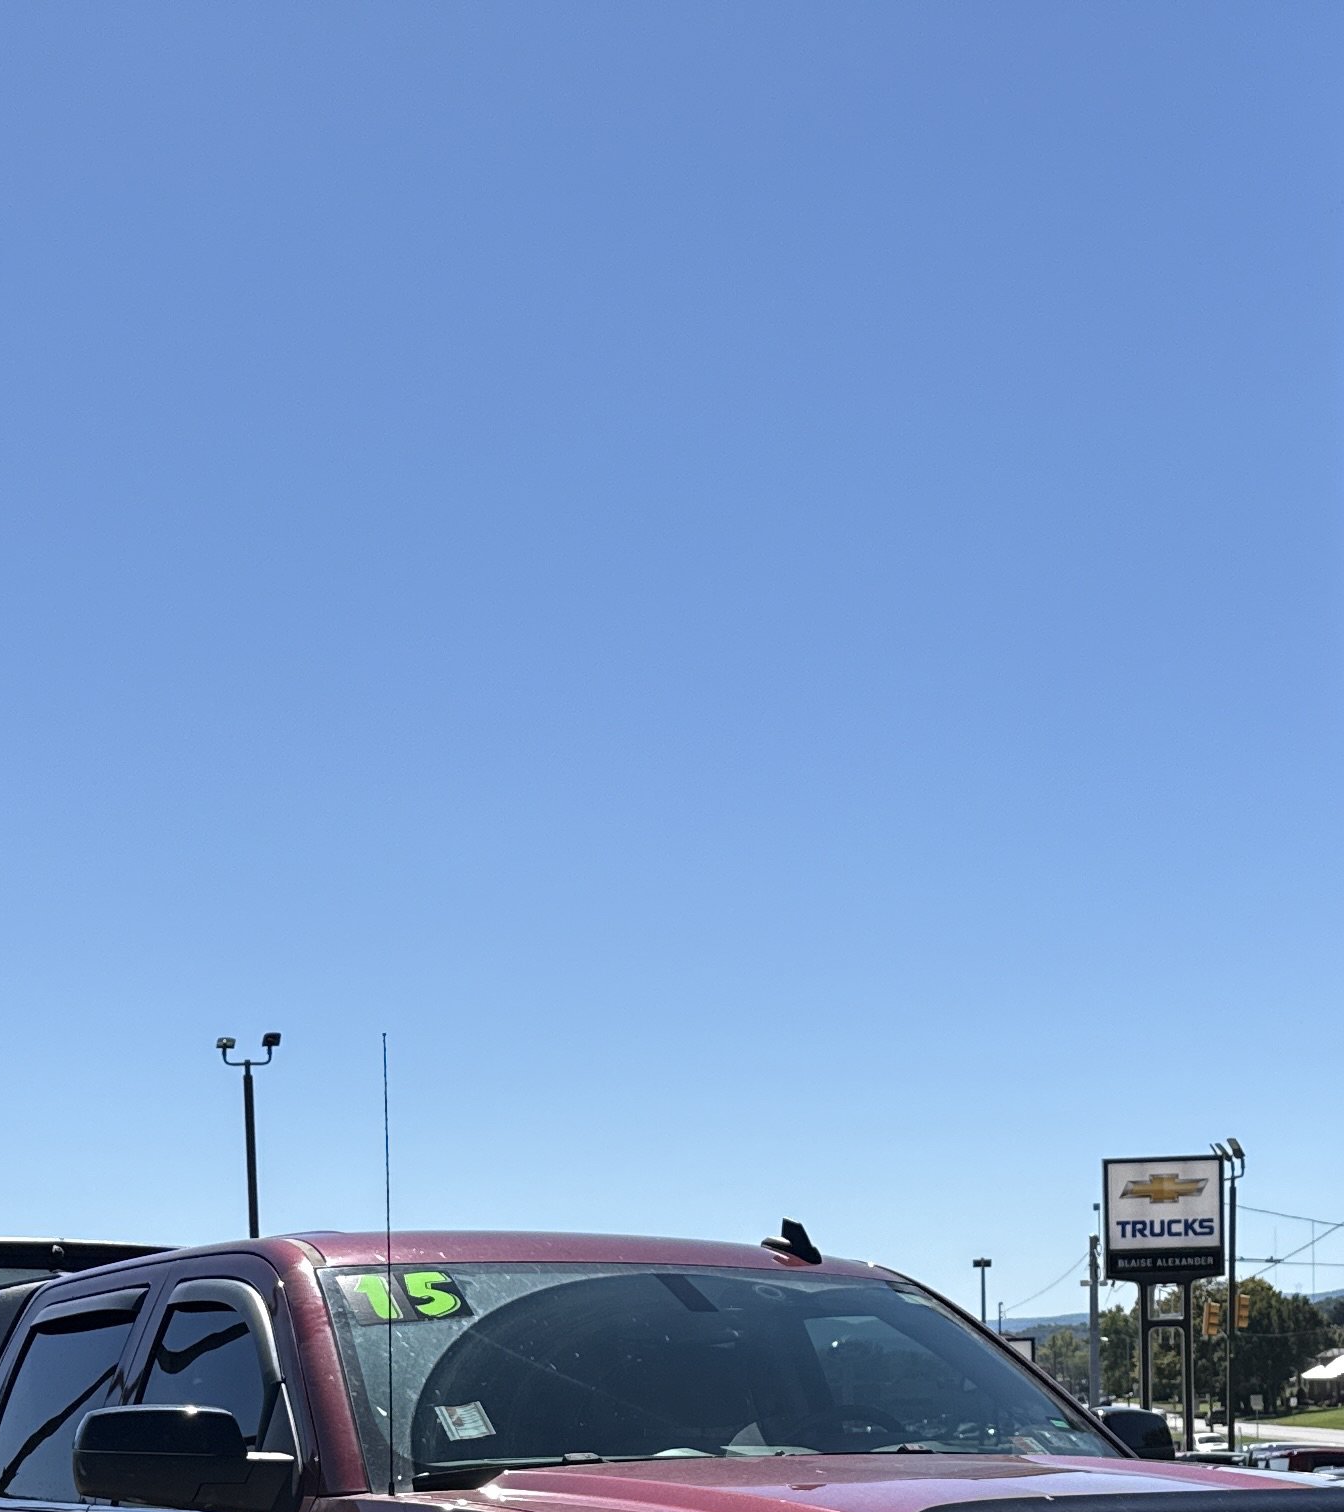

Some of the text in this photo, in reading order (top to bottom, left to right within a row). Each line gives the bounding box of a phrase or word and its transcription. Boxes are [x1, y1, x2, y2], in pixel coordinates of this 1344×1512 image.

[1116, 1218, 1215, 1238] TRUCKS
[1117, 1255, 1214, 1268] BLAISE ALEXANDER
[353, 1270, 462, 1319] 15
